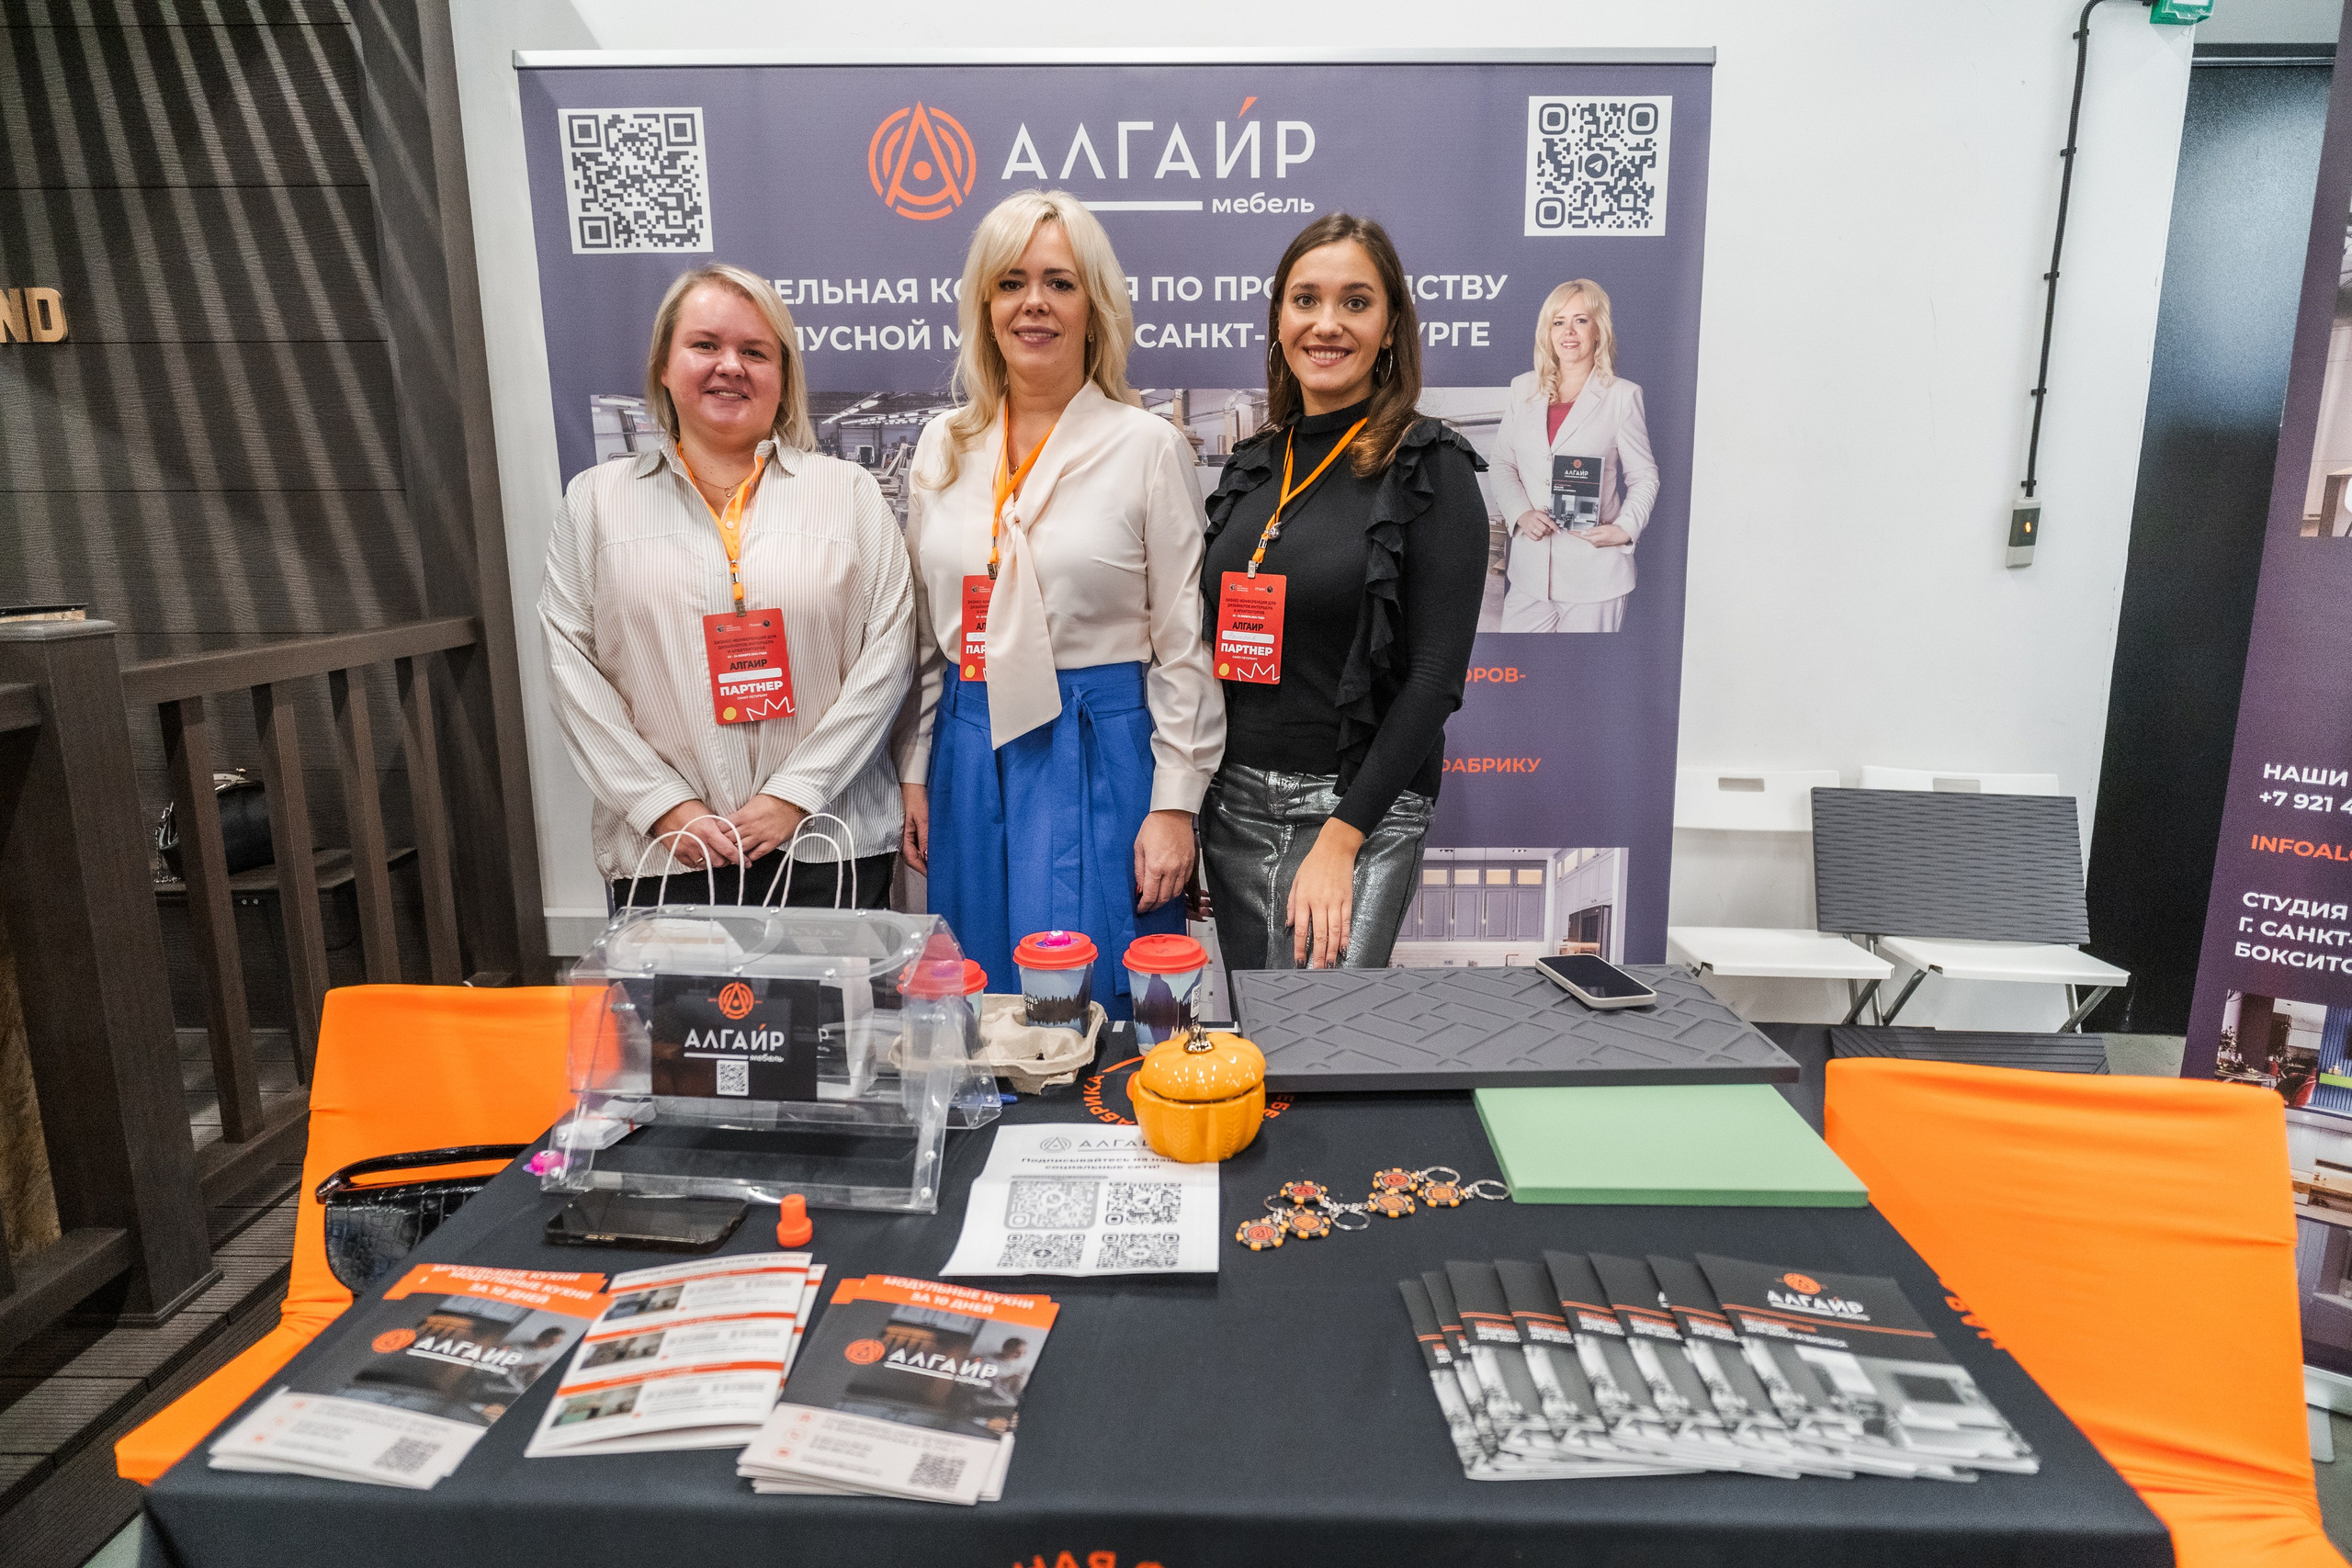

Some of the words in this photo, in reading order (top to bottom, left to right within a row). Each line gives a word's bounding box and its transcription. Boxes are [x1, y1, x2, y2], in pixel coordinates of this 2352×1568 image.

[1213, 192, 1315, 213] мебель
[766, 277, 918, 305] ЕЛЬНАЯ
[1152, 276, 1203, 301] ПО
[1135, 323, 1265, 348] САНКТ-
[1232, 621, 1264, 631] АЛГАИР
[1220, 642, 1273, 657] ПАРТНЕР
[729, 659, 768, 671] АЛГАИР
[719, 681, 784, 696] ПАРТНЕР
[2263, 763, 2348, 787] НАШИ
[2259, 791, 2288, 807] +7
[2293, 794, 2334, 812] 921
[2251, 834, 2352, 862] INFOAL
[2243, 892, 2348, 920] СТУДИЯ
[2238, 916, 2254, 933] Г.
[468, 1283, 489, 1293] ЗА
[503, 1290, 551, 1304] ДНЕЙ
[543, 1283, 594, 1301] КУХНИ
[883, 1276, 980, 1300] МОДУЛЬНЫЕ
[982, 1292, 1035, 1310] КУХНИ
[910, 1292, 930, 1303] ЗА
[949, 1300, 995, 1314] ДНЕЙ
